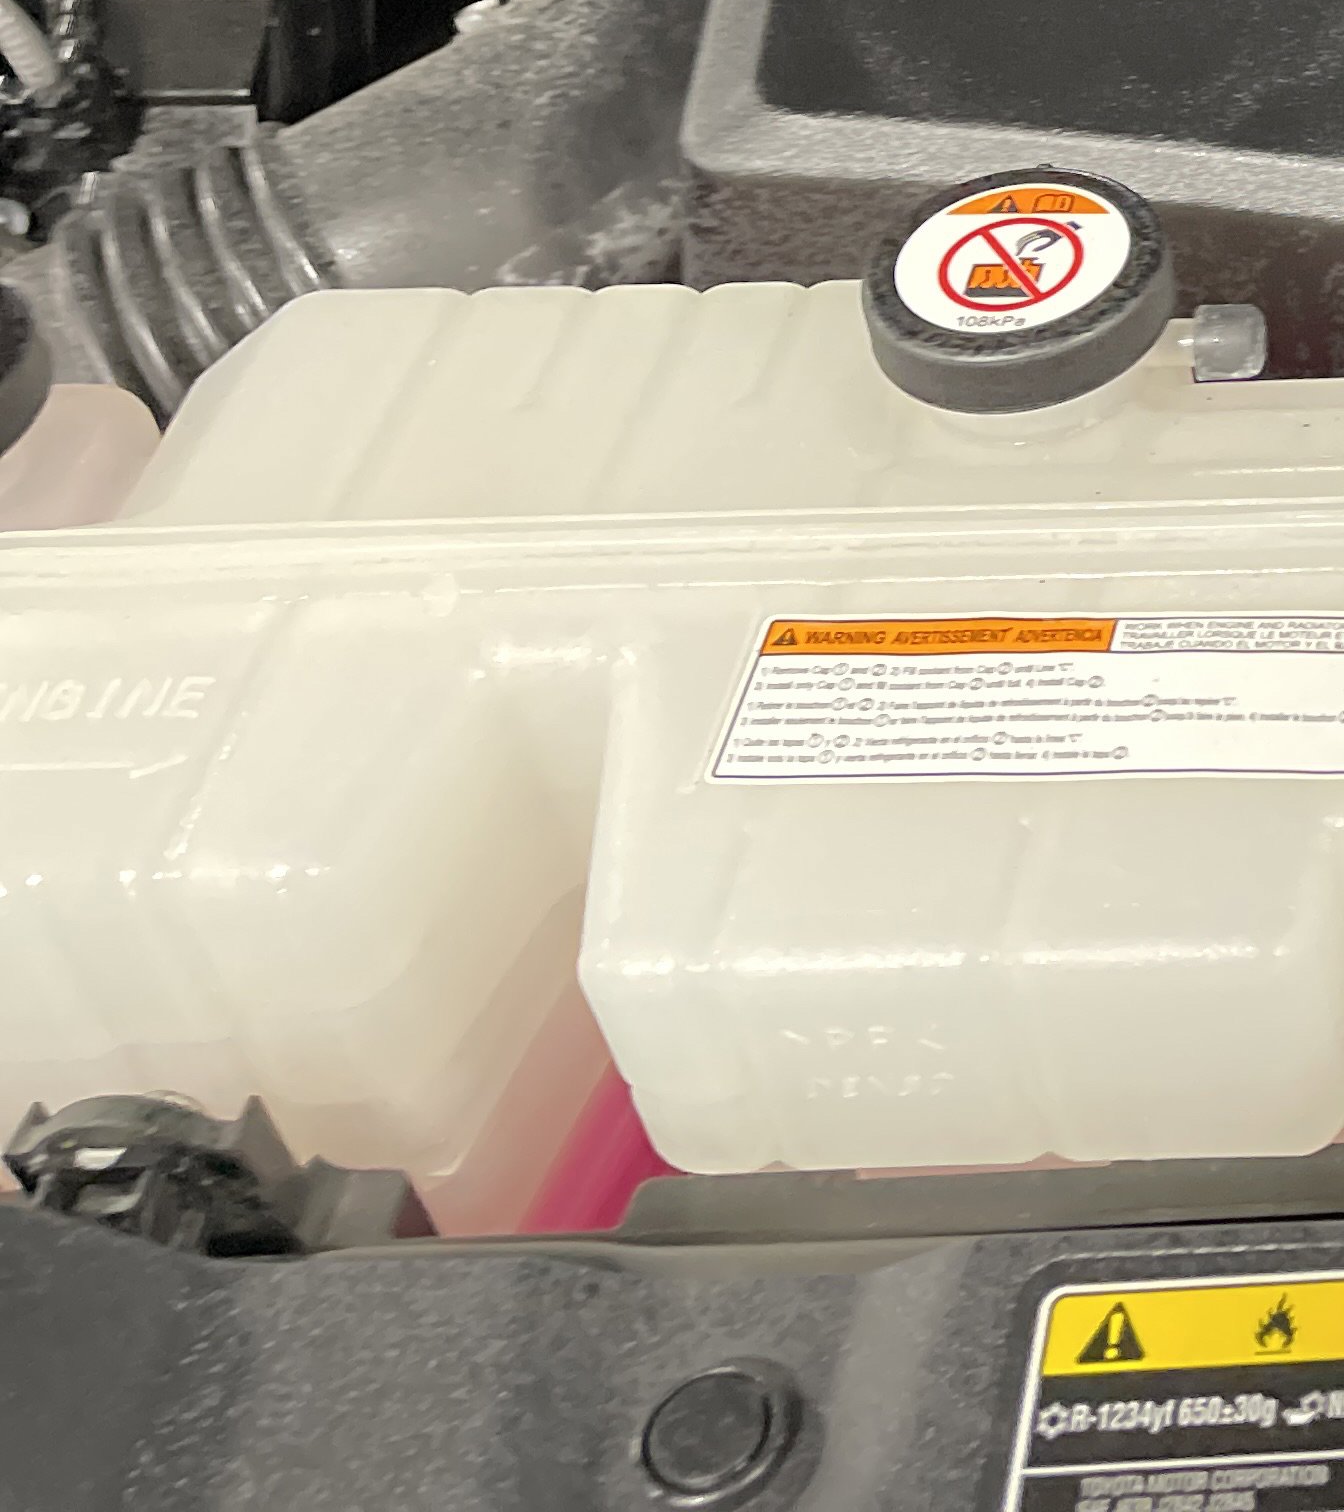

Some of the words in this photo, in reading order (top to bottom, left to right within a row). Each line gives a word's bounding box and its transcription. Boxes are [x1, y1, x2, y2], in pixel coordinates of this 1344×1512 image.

[956, 315, 1026, 327] 108kPa
[804, 630, 887, 645] WARNING
[0, 676, 217, 723] NGINE
[1071, 1399, 1176, 1434] R-1234yf
[1178, 1392, 1279, 1429] 650±30g
